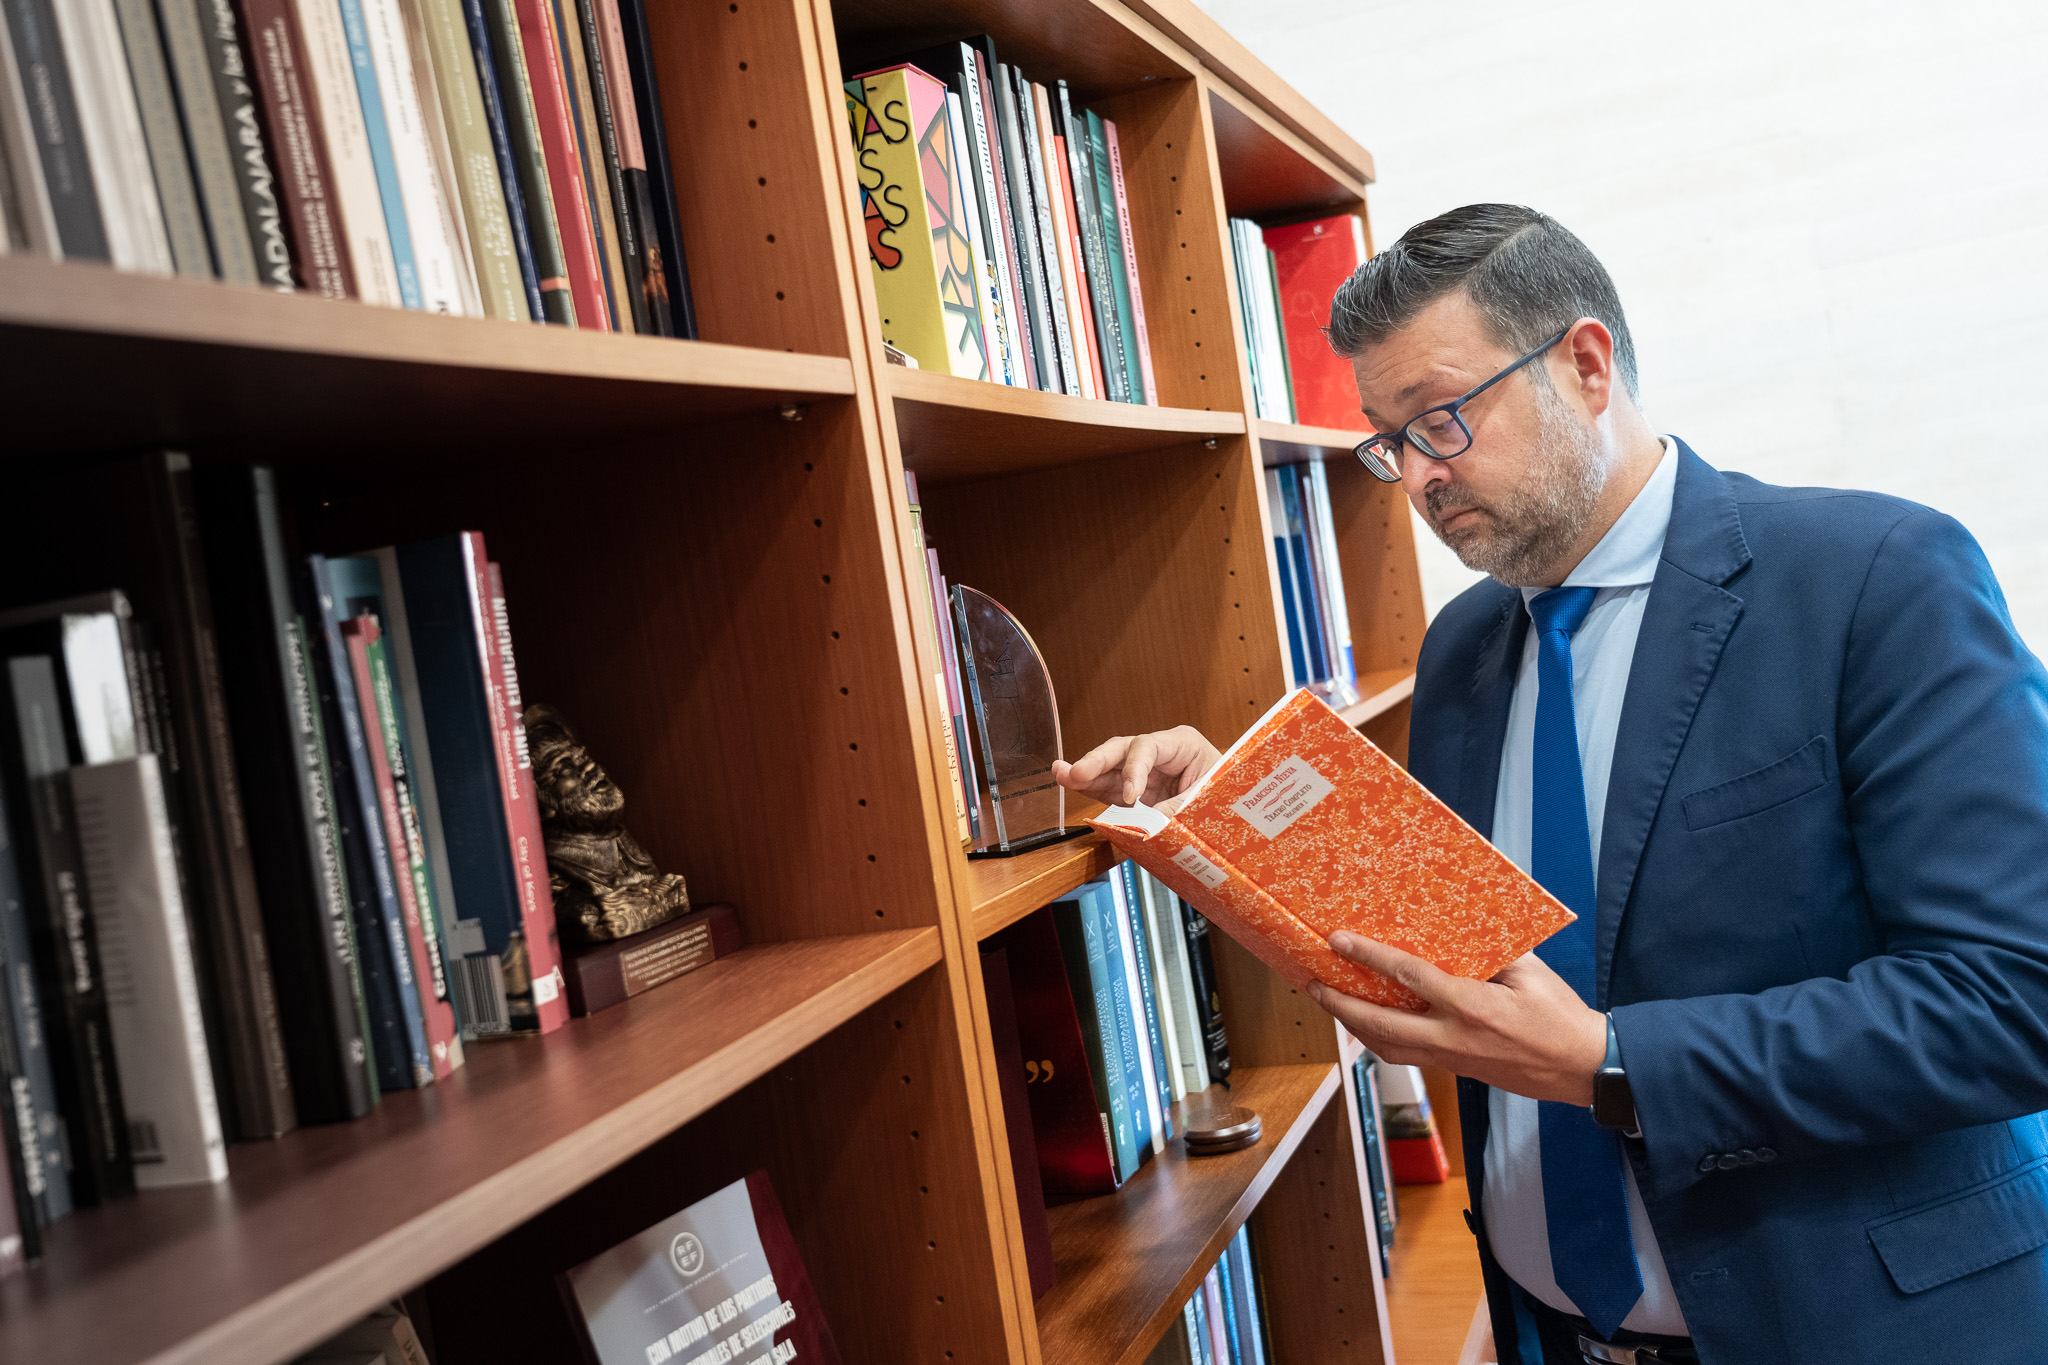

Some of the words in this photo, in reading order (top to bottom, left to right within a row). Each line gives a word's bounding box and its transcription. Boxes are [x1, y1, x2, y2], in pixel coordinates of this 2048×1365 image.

[965, 54, 979, 96] Arte
[972, 100, 993, 176] español
[1111, 145, 1124, 199] WERNER
[1014, 220, 1031, 265] fuego
[1023, 267, 1033, 285] El
[1025, 325, 1035, 358] JUAN
[491, 684, 510, 728] Leiden
[303, 742, 320, 767] EL
[497, 729, 523, 800] Sleutelstad
[513, 724, 531, 769] CINE
[308, 769, 329, 818] POR
[1242, 781, 1278, 809] FRANCISCO
[1273, 766, 1297, 785] NIEVA
[1264, 804, 1287, 823] TEATRO
[1284, 783, 1312, 811] COMPLETO
[398, 780, 424, 868] popular
[1283, 803, 1306, 819] VOLUMEN
[316, 820, 345, 916] BRINDIS
[515, 835, 531, 862] City
[520, 862, 533, 880] of
[1207, 874, 1215, 882] 1
[521, 880, 539, 913] Keys
[412, 870, 447, 998] Cancionero
[646, 1337, 672, 1365] CON
[667, 1315, 709, 1354] MOTIVO
[704, 1307, 721, 1331] DE
[716, 1298, 739, 1324] LOS
[733, 1273, 778, 1314] PARTIDOS
[727, 1333, 744, 1356] DE
[739, 1299, 797, 1349] SELECCIONES
[771, 1338, 798, 1365] SALA
